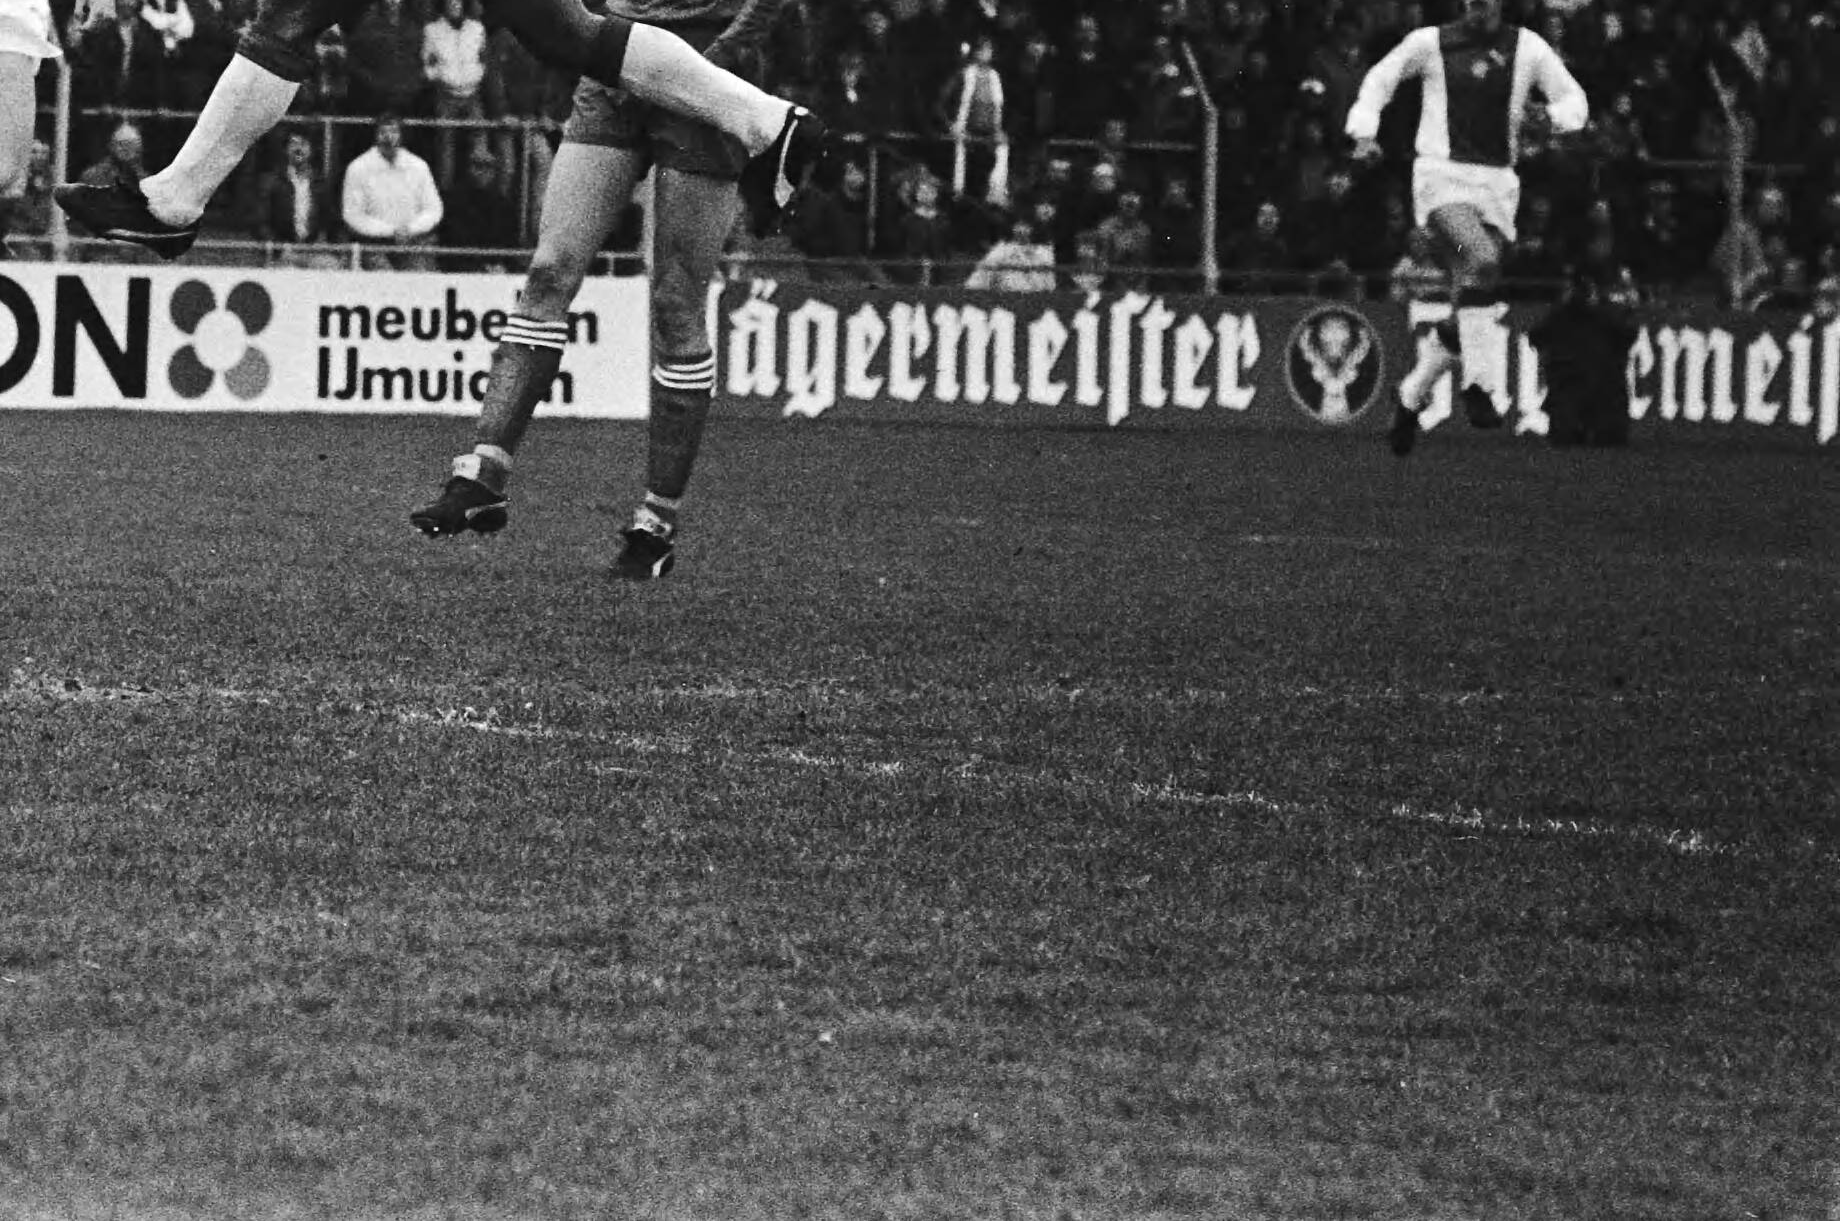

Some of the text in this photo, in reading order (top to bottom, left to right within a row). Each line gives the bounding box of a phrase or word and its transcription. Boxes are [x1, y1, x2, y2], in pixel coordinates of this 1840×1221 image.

[317, 287, 598, 344] meuben
[316, 345, 573, 404] IJmuin
[706, 277, 1259, 426] ägermeister
